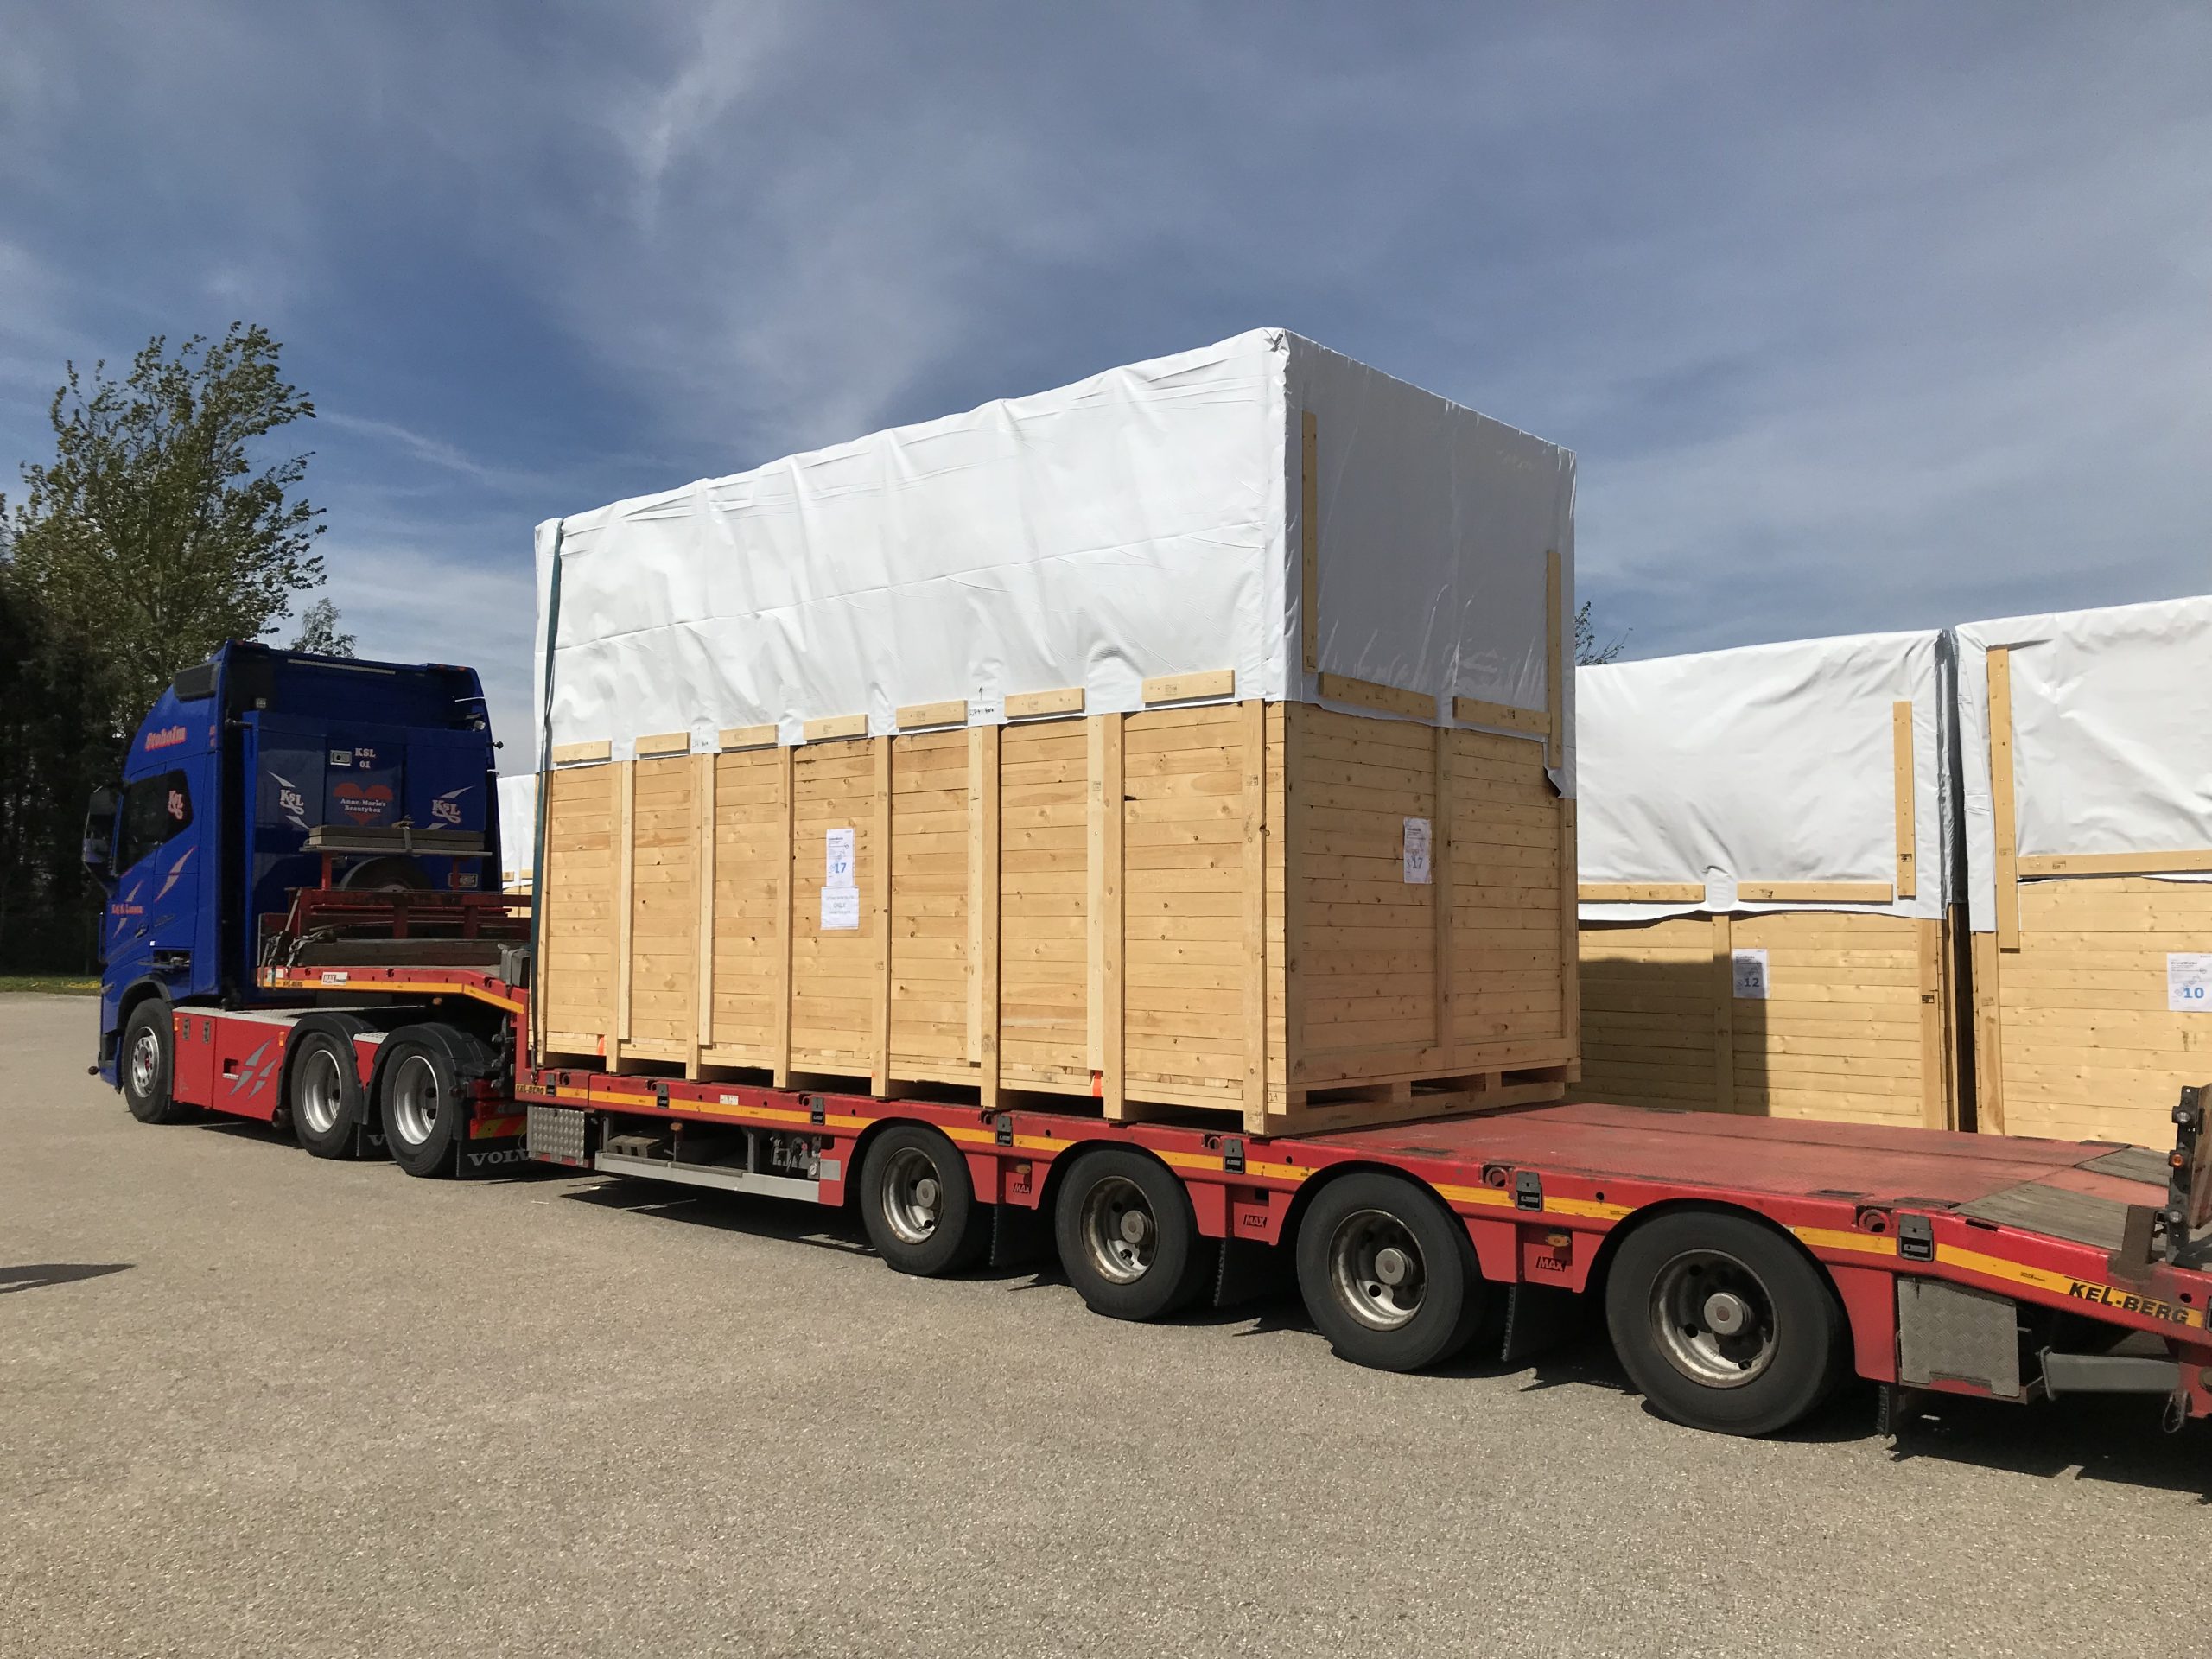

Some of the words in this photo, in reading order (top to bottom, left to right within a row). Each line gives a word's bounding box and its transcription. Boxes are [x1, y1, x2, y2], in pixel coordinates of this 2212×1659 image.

[355, 747, 376, 758] KSL
[280, 789, 304, 815] KSL
[344, 804, 381, 813] Beautybox
[432, 799, 461, 823] KSL
[835, 862, 847, 873] 17
[1411, 857, 1423, 868] 17
[1745, 977, 1760, 988] 12
[2183, 987, 2205, 999] 10
[516, 1084, 544, 1095] KEL-BERG
[467, 1149, 530, 1166] VOLV
[1014, 1182, 1031, 1194] MAX
[1244, 1215, 1266, 1227] MAX
[1537, 1256, 1565, 1271] MAX
[2069, 1281, 2189, 1325] KEL-BERG
